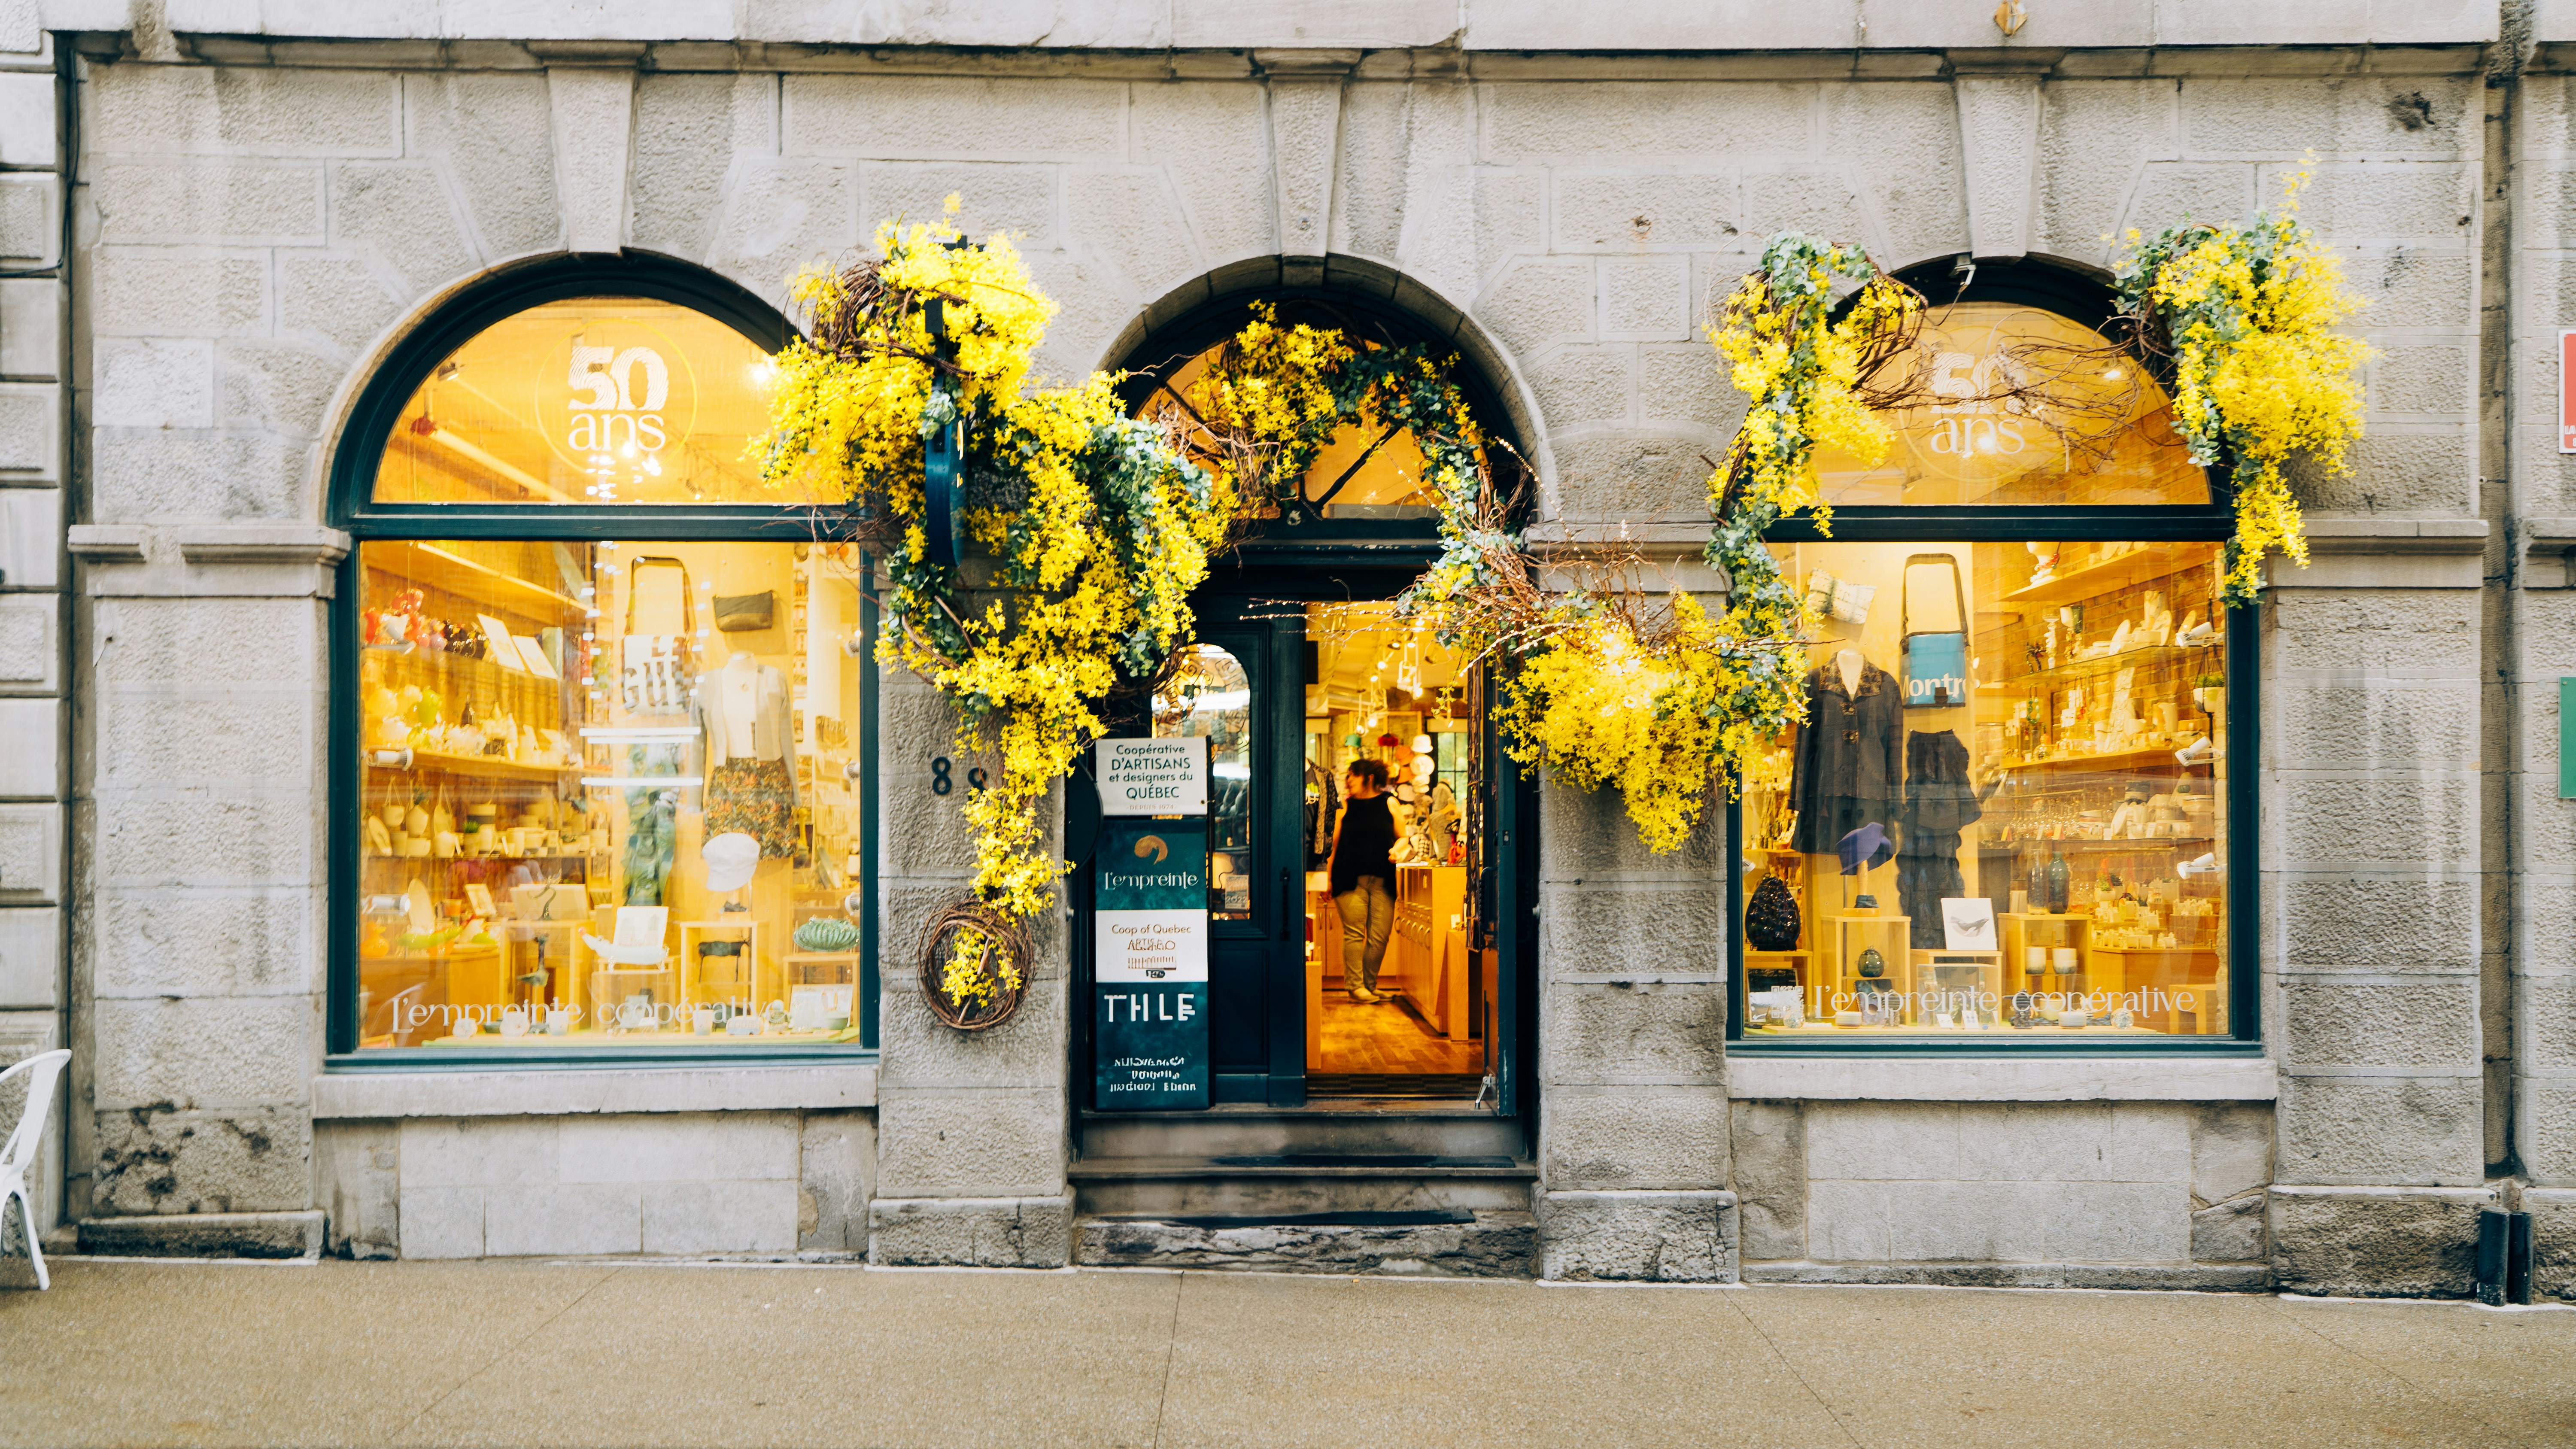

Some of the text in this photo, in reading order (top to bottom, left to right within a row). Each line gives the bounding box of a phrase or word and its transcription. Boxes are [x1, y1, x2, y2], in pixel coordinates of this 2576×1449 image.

[567, 345, 668, 411] 50
[1930, 352, 2028, 414] 50
[568, 413, 666, 452] ans
[1931, 416, 2025, 455] ans
[1116, 744, 1185, 757] Coopérative
[1109, 772, 1193, 784] et designers du
[1126, 784, 1180, 800] QUÉBEC
[1112, 923, 1192, 936] Coop of Quebec
[596, 995, 787, 1030] coopérative
[2012, 985, 2198, 1018] coopérative
